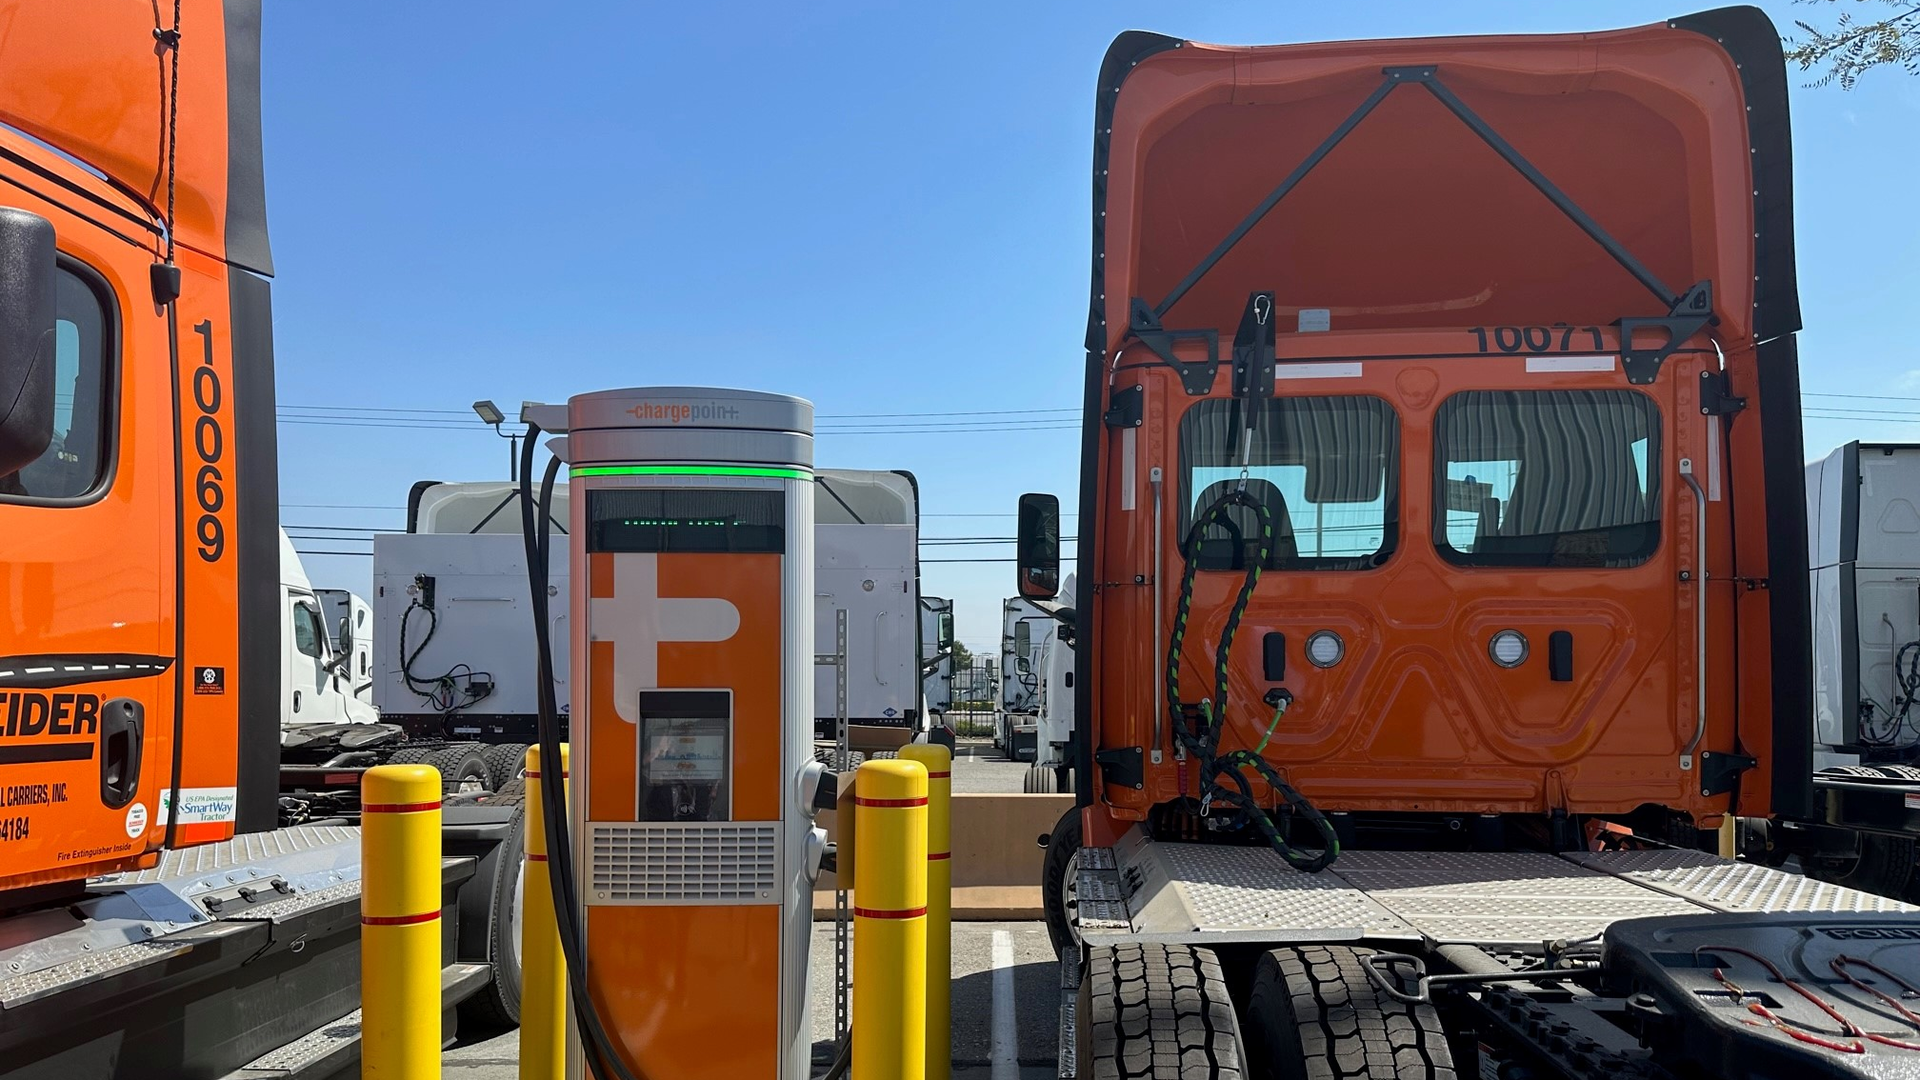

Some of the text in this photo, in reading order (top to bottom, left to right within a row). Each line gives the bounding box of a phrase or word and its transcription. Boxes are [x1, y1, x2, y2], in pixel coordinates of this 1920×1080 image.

[1467, 325, 1604, 352] 10071
[193, 318, 225, 563] 10069
[7, 783, 50, 807] CARRIERS,
[52, 782, 68, 803] INC.
[184, 802, 233, 814] SmartWay
[200, 813, 226, 821] Tractor
[57, 842, 132, 861] Fire Extinguisher Inside
